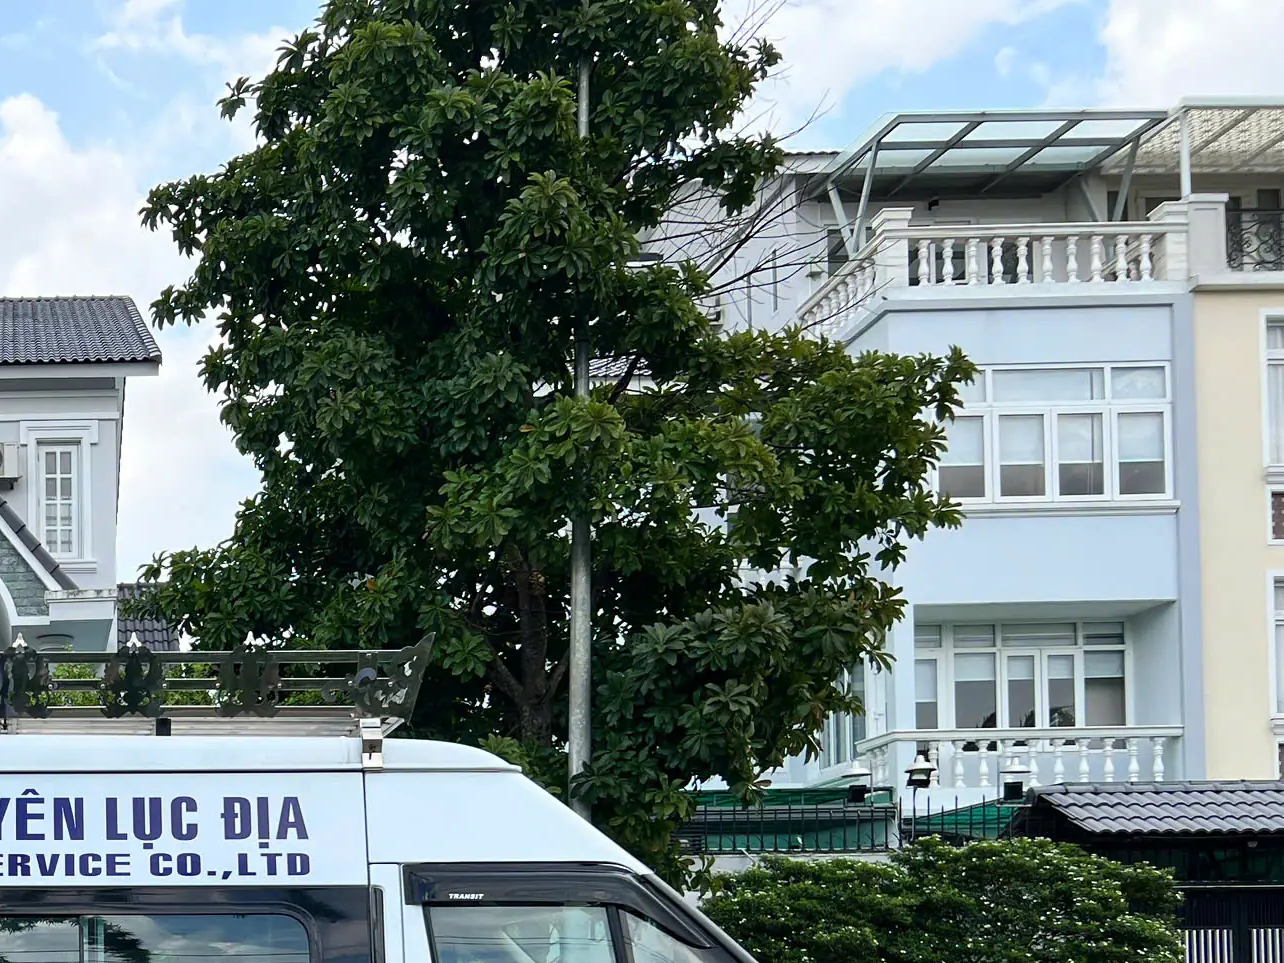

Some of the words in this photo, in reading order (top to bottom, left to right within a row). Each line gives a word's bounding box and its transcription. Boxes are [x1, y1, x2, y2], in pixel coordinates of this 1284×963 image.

[105, 796, 199, 850] LỤC
[220, 796, 309, 849] ĐỊA
[149, 853, 311, 880] CO.,LTD
